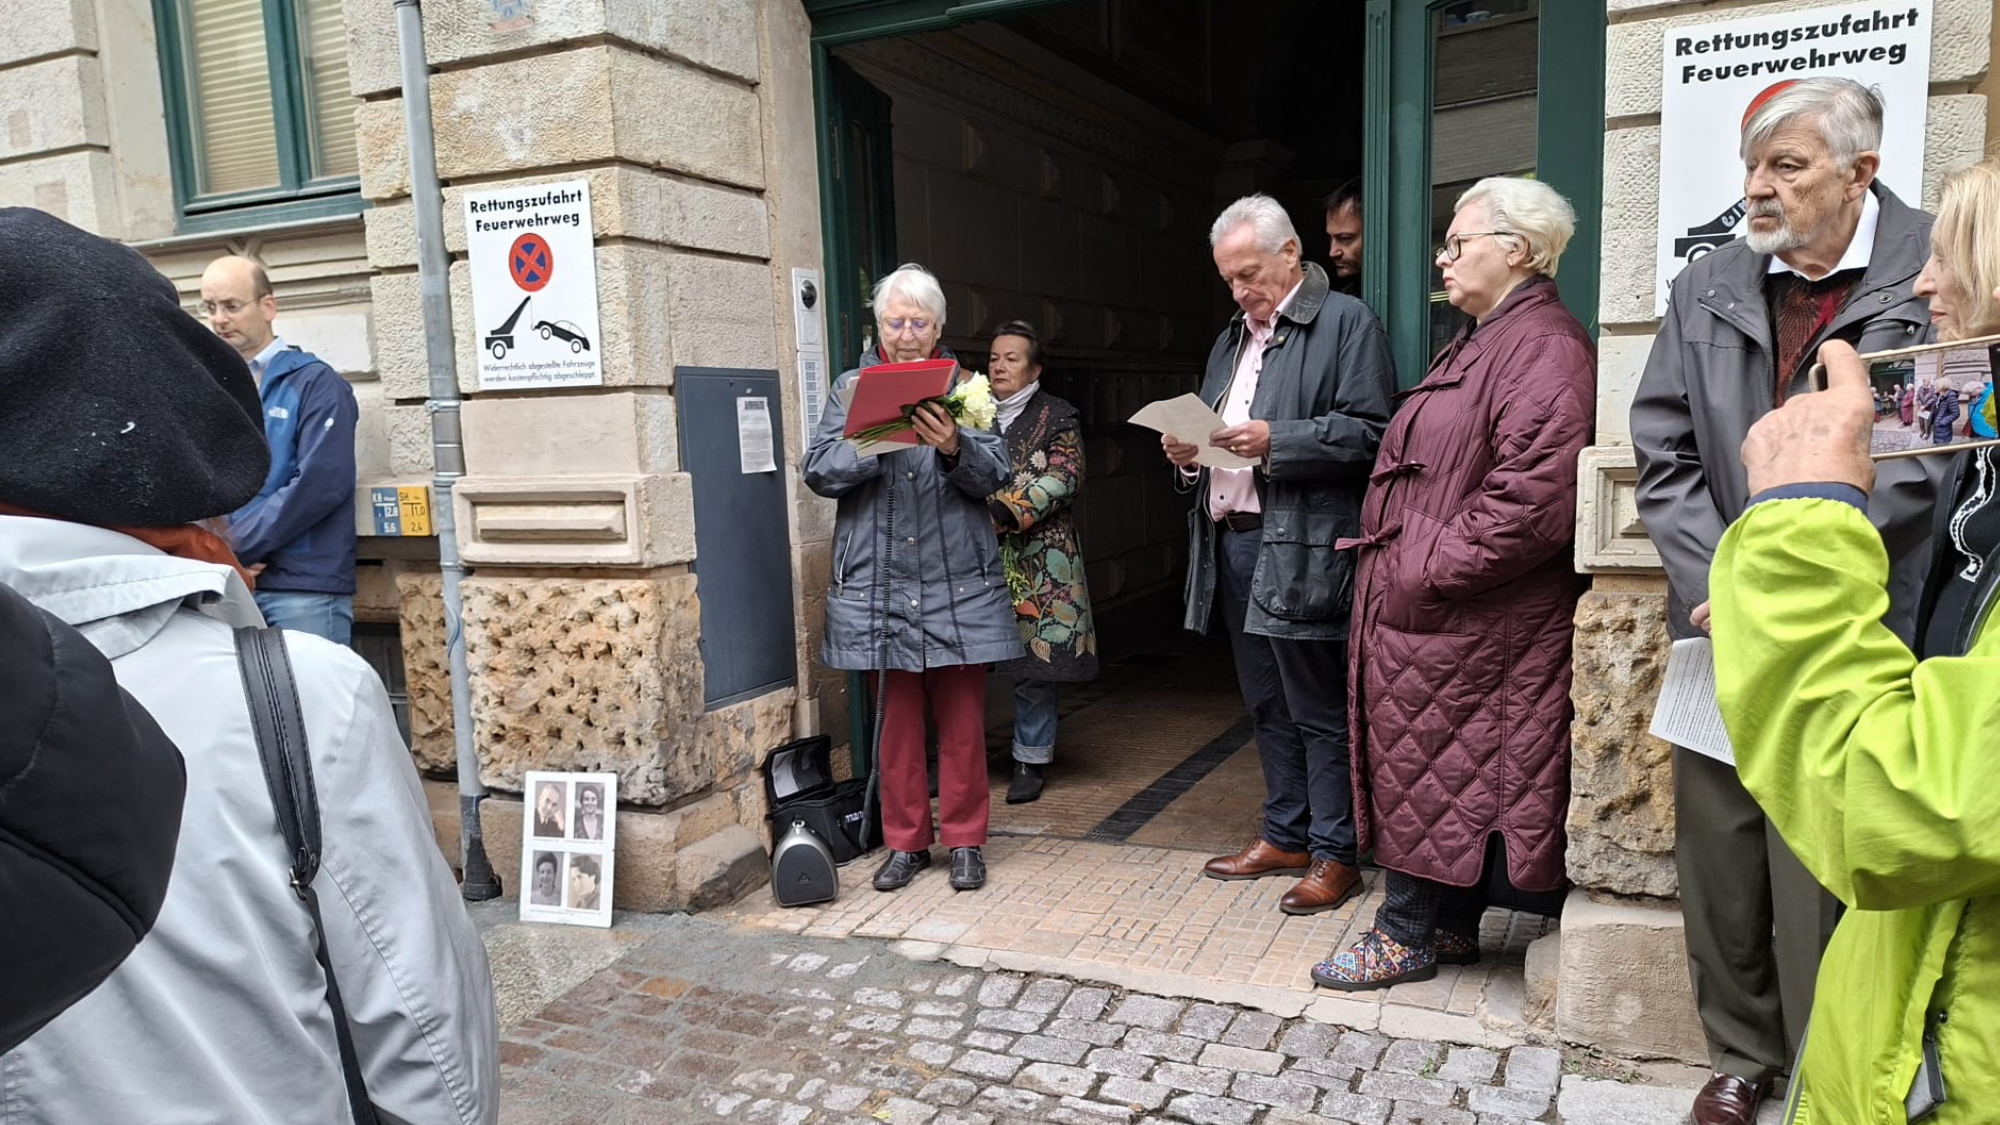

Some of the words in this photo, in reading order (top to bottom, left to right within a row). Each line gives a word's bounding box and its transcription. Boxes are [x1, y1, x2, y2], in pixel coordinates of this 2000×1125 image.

[1675, 8, 1919, 56] Rettungszufahrt
[1682, 43, 1907, 84] Feuerwehrweg
[470, 189, 582, 213] Rettungszufahrt
[476, 212, 580, 232] Feuerwehrweg
[483, 363, 526, 371] Widerrechtlich
[528, 361, 561, 371] abgestellte
[563, 360, 595, 369] Fahrzeuge
[484, 374, 506, 382] werden
[508, 371, 552, 383] kostenpflichtig
[554, 370, 596, 381] abgeschleppt.
